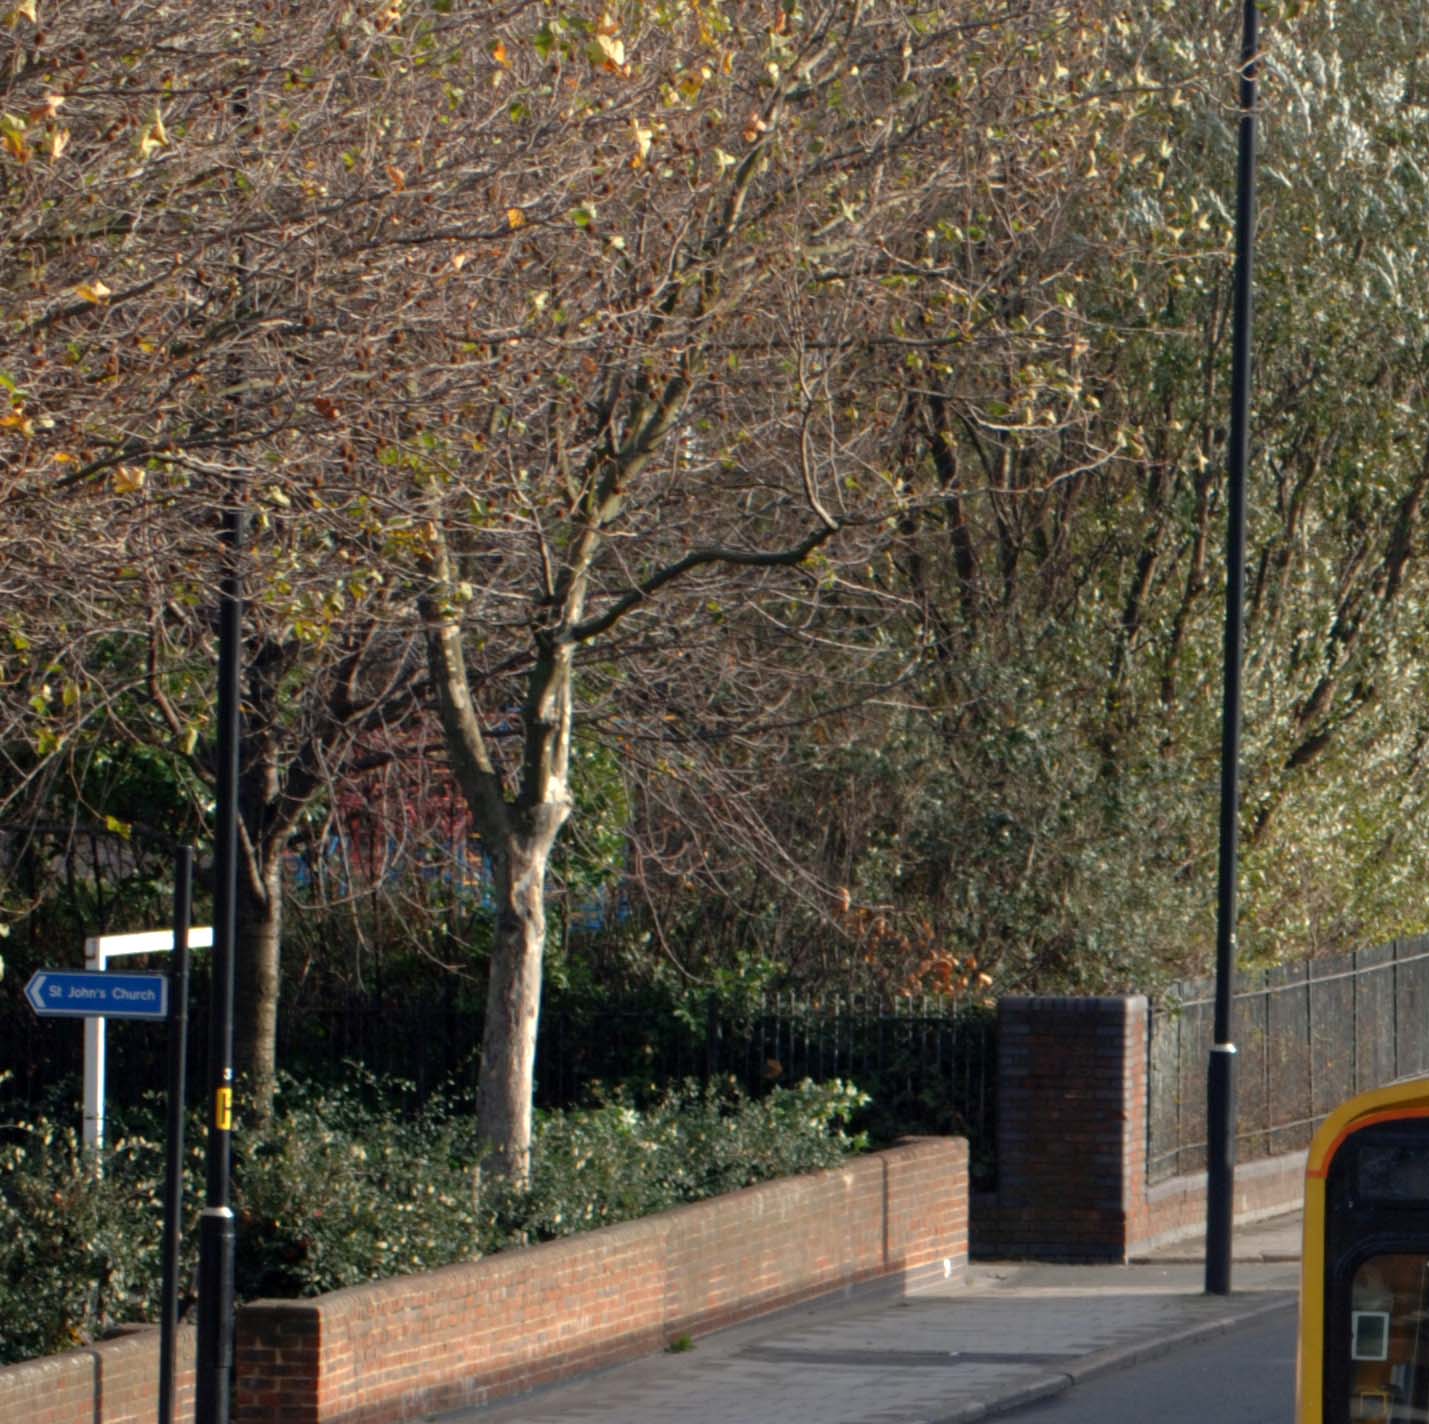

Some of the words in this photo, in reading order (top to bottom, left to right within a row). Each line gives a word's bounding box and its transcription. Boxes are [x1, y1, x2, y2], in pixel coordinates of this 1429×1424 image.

[49, 985, 62, 998] St
[68, 986, 106, 999] John's
[112, 987, 156, 1001] Church
